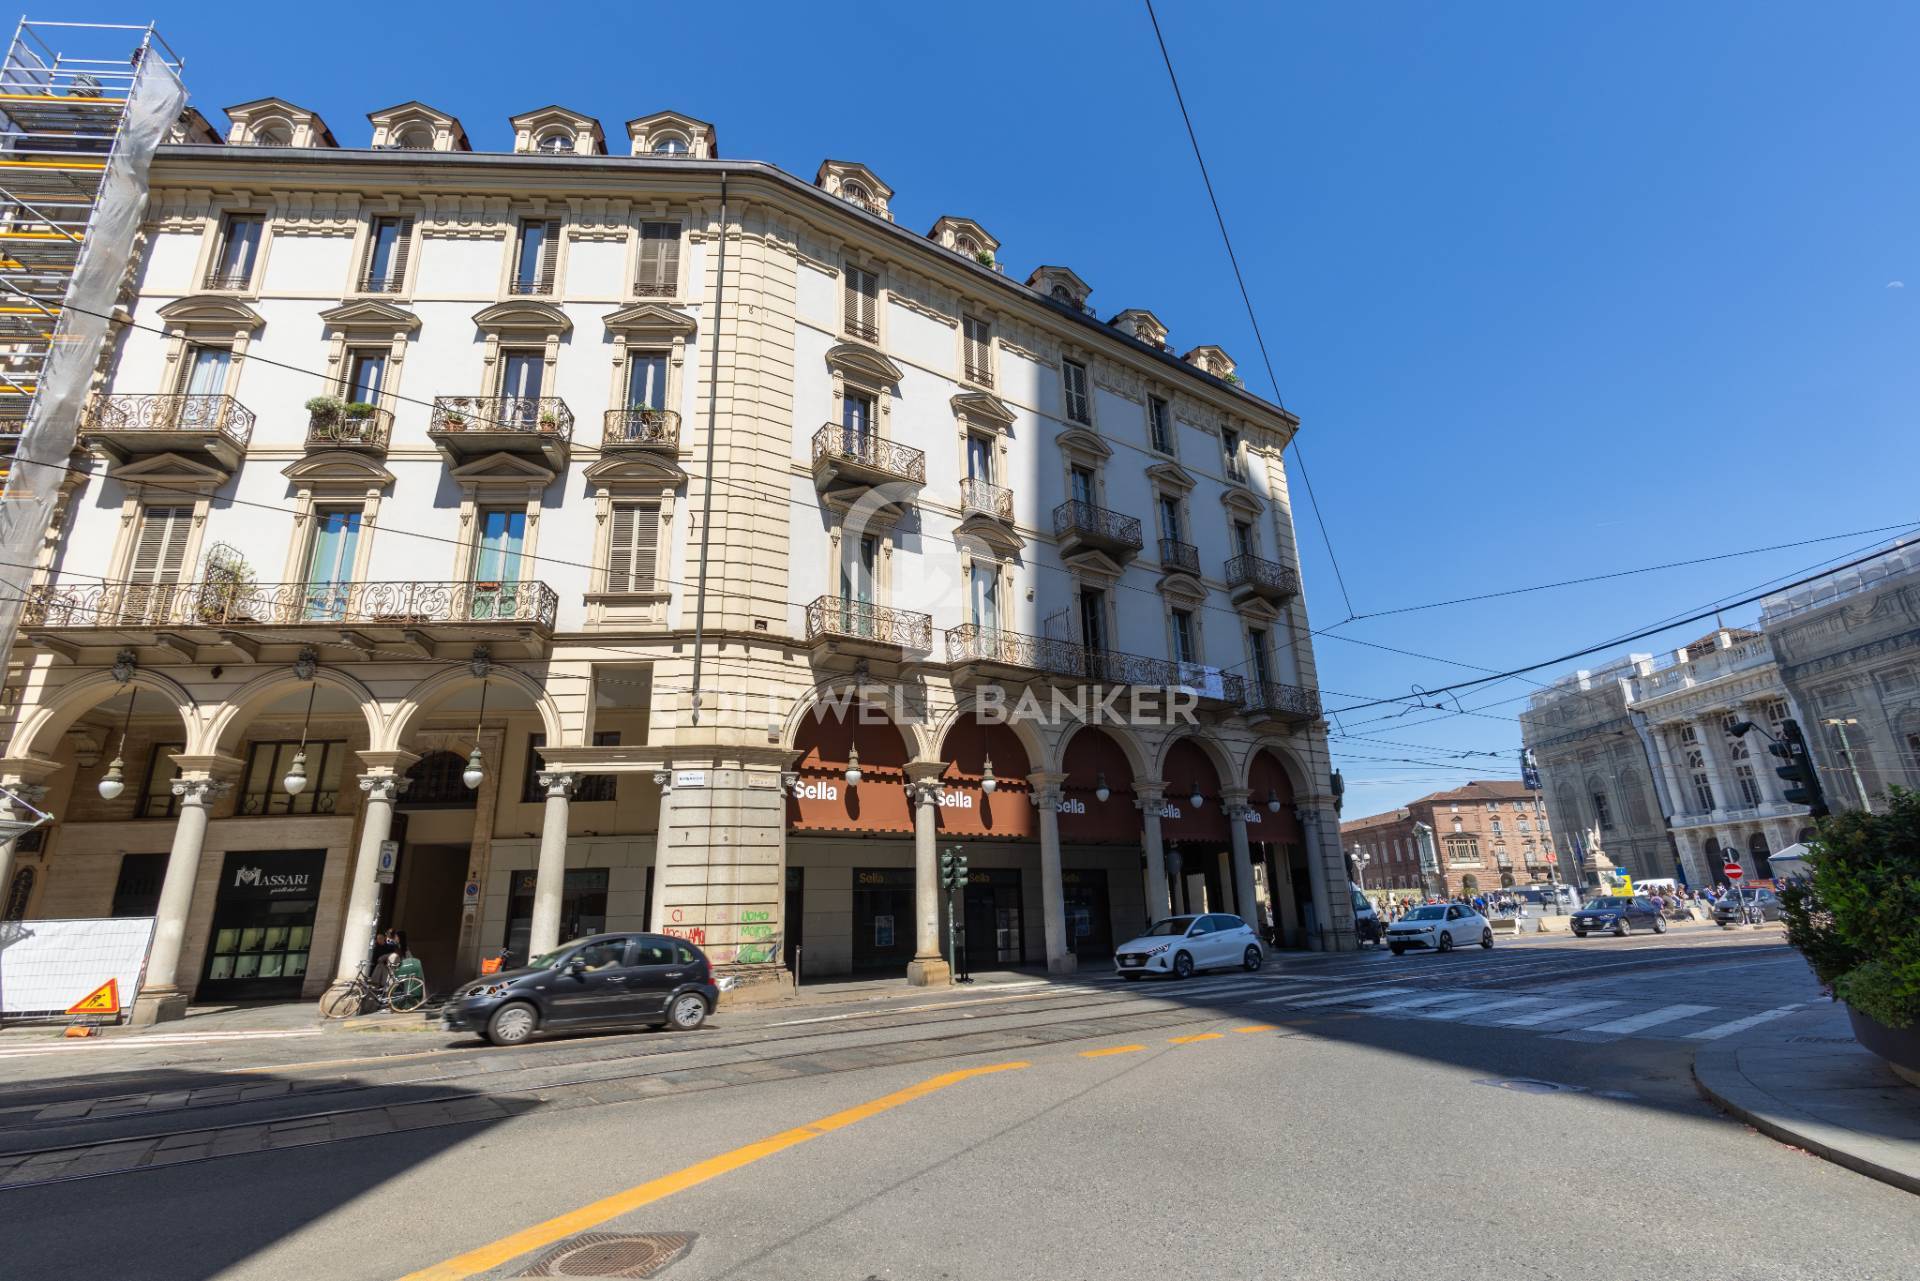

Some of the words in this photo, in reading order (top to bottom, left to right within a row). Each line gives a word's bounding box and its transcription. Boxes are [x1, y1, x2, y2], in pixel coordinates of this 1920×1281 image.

[795, 781, 837, 800] Sella
[938, 791, 972, 808] Sella
[1244, 808, 1262, 823] ella
[234, 867, 309, 887] MASSARI
